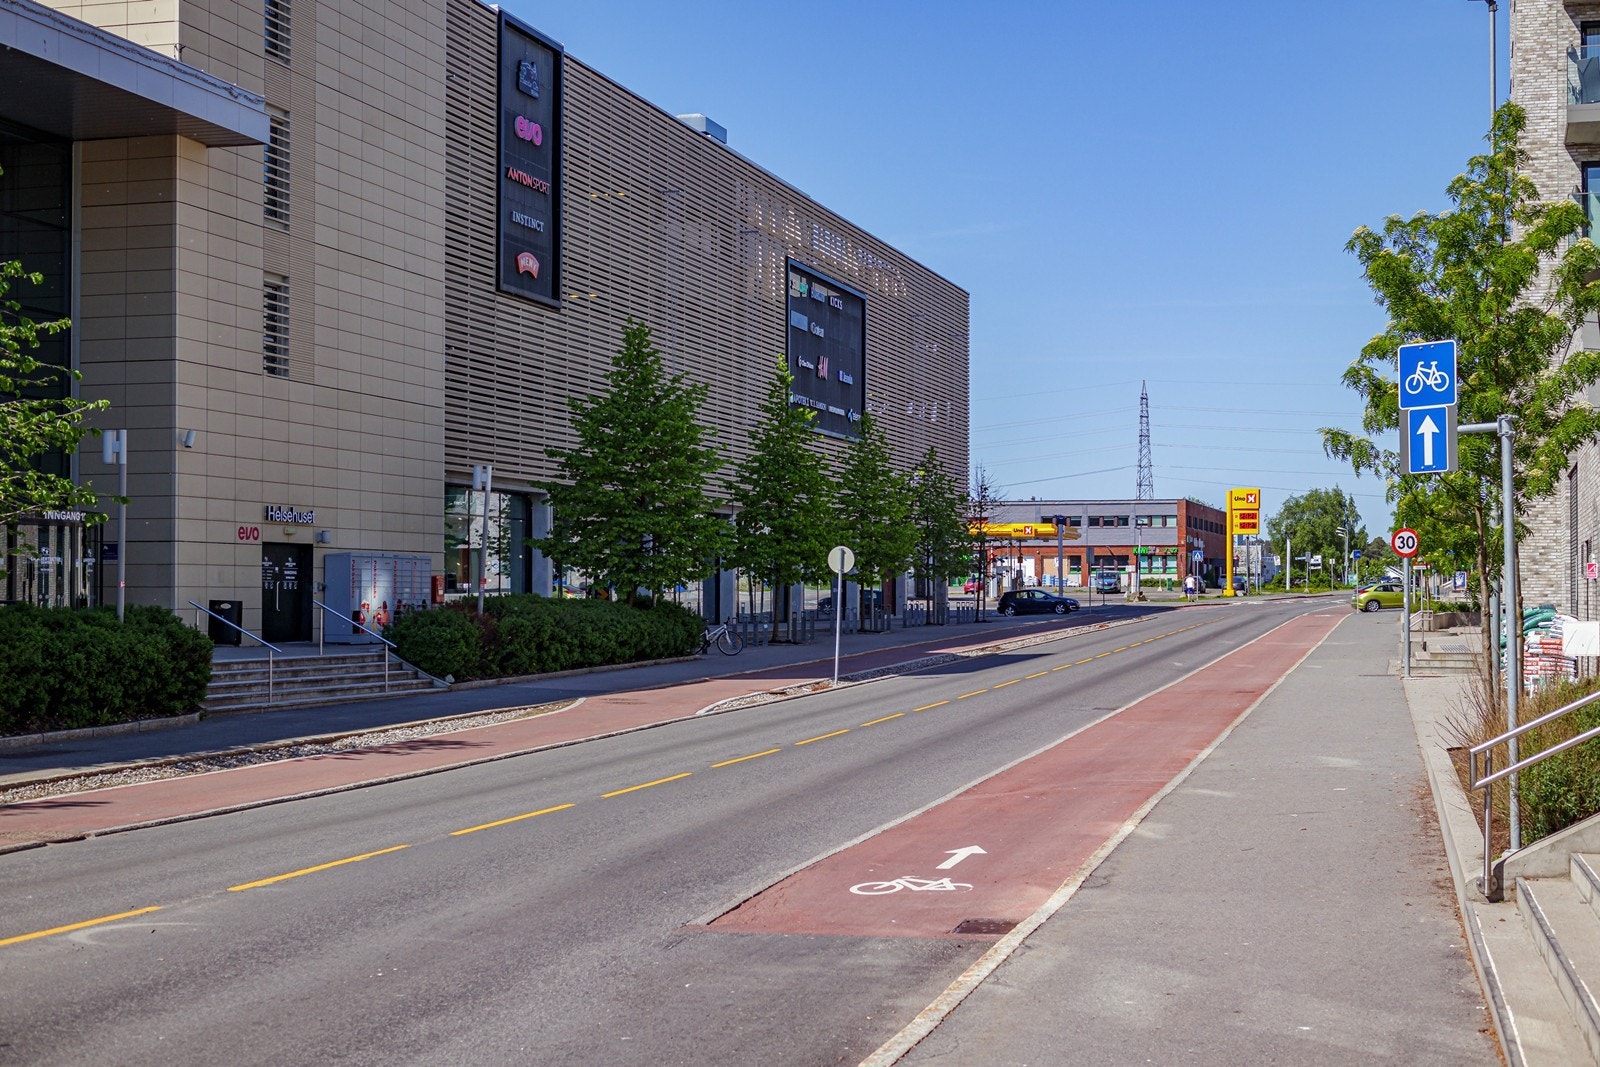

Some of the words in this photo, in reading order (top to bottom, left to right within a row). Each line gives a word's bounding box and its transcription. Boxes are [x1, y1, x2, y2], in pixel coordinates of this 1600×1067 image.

[515, 115, 542, 146] evo
[512, 210, 545, 233] INSTINCT
[1247, 494, 1256, 503] X
[44, 510, 80, 521] INNGANG
[267, 505, 315, 524] Helsehuset
[238, 526, 259, 540] evo
[1397, 535, 1415, 549] 30
